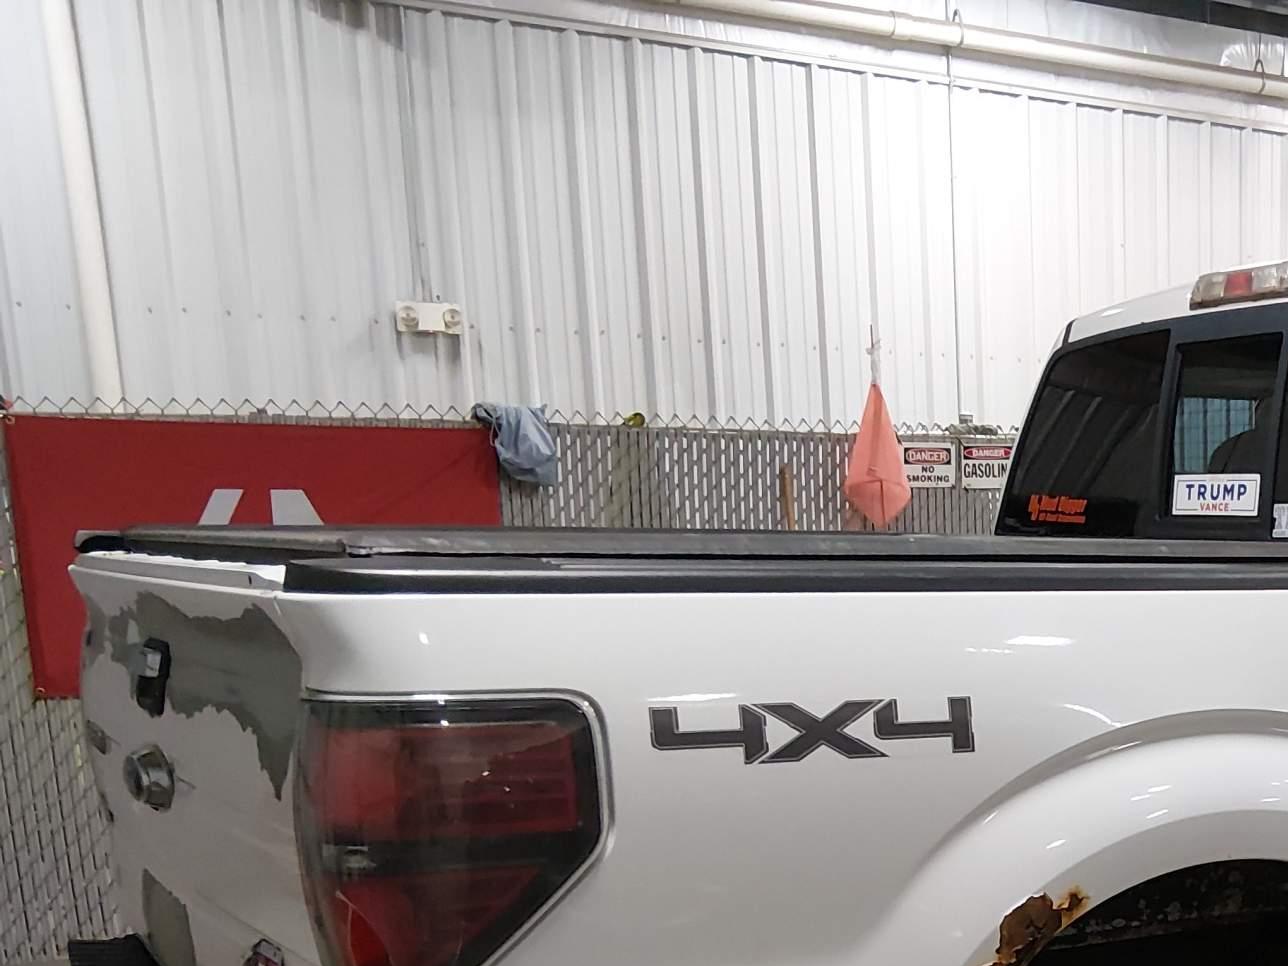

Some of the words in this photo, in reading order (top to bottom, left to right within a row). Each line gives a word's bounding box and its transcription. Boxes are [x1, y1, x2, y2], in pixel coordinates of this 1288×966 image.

[909, 449, 947, 461] DANGER
[972, 449, 1005, 458] DANGER
[921, 465, 935, 474] NO
[963, 462, 1008, 479] GASOLIN
[906, 474, 950, 483] SMOKING
[1185, 483, 1248, 501] TRUMP
[1199, 502, 1230, 512] VANCE
